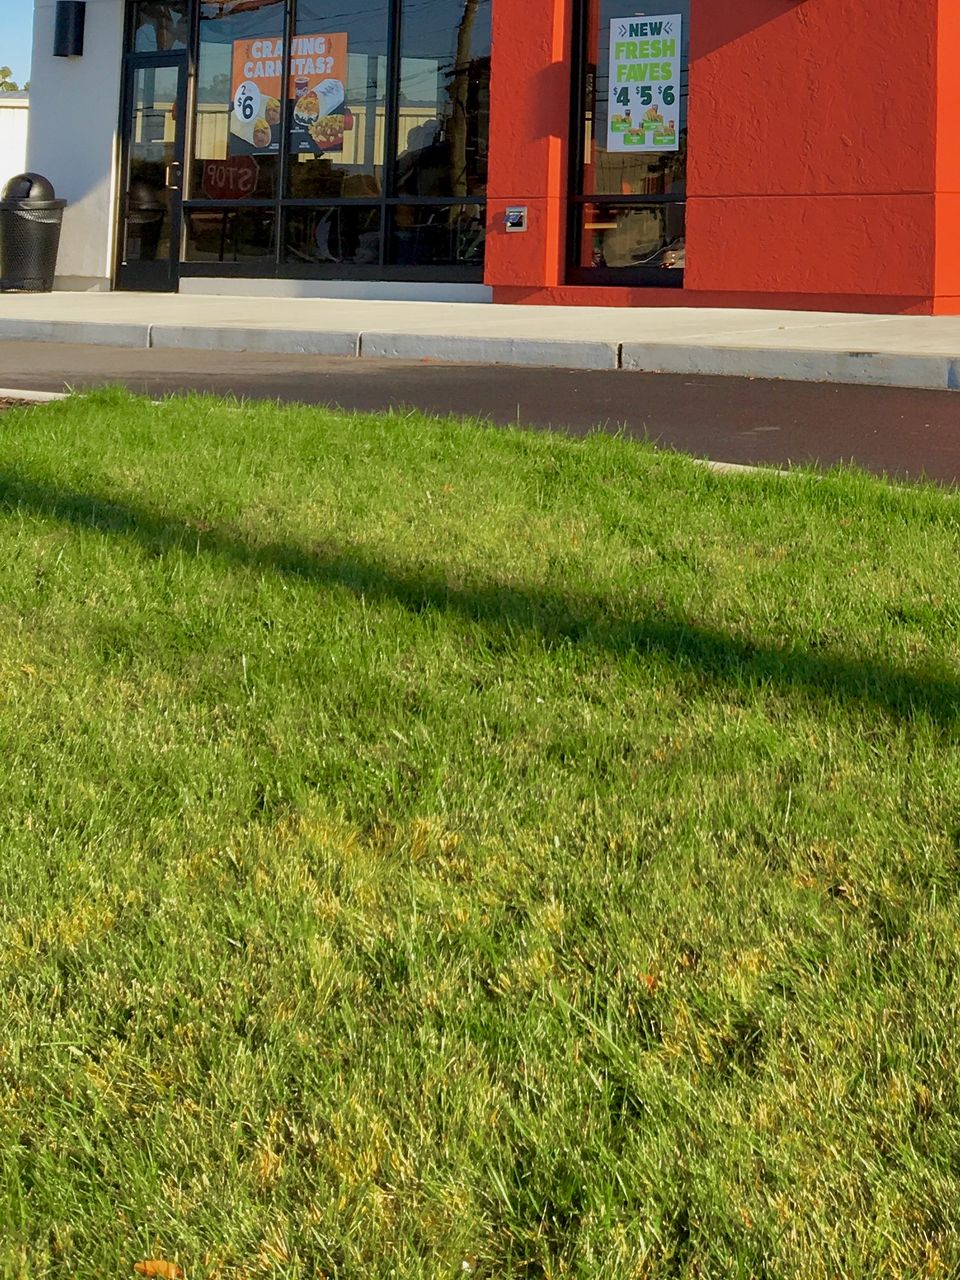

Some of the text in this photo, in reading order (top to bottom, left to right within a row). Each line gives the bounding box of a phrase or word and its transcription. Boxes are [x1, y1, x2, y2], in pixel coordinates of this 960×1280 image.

[629, 22, 663, 37] NEW
[614, 39, 676, 60] FRESH
[616, 62, 673, 83] FAVES
[241, 84, 247, 96] 2
[613, 85, 675, 106] $4 $5 $6
[237, 95, 254, 120] $6
